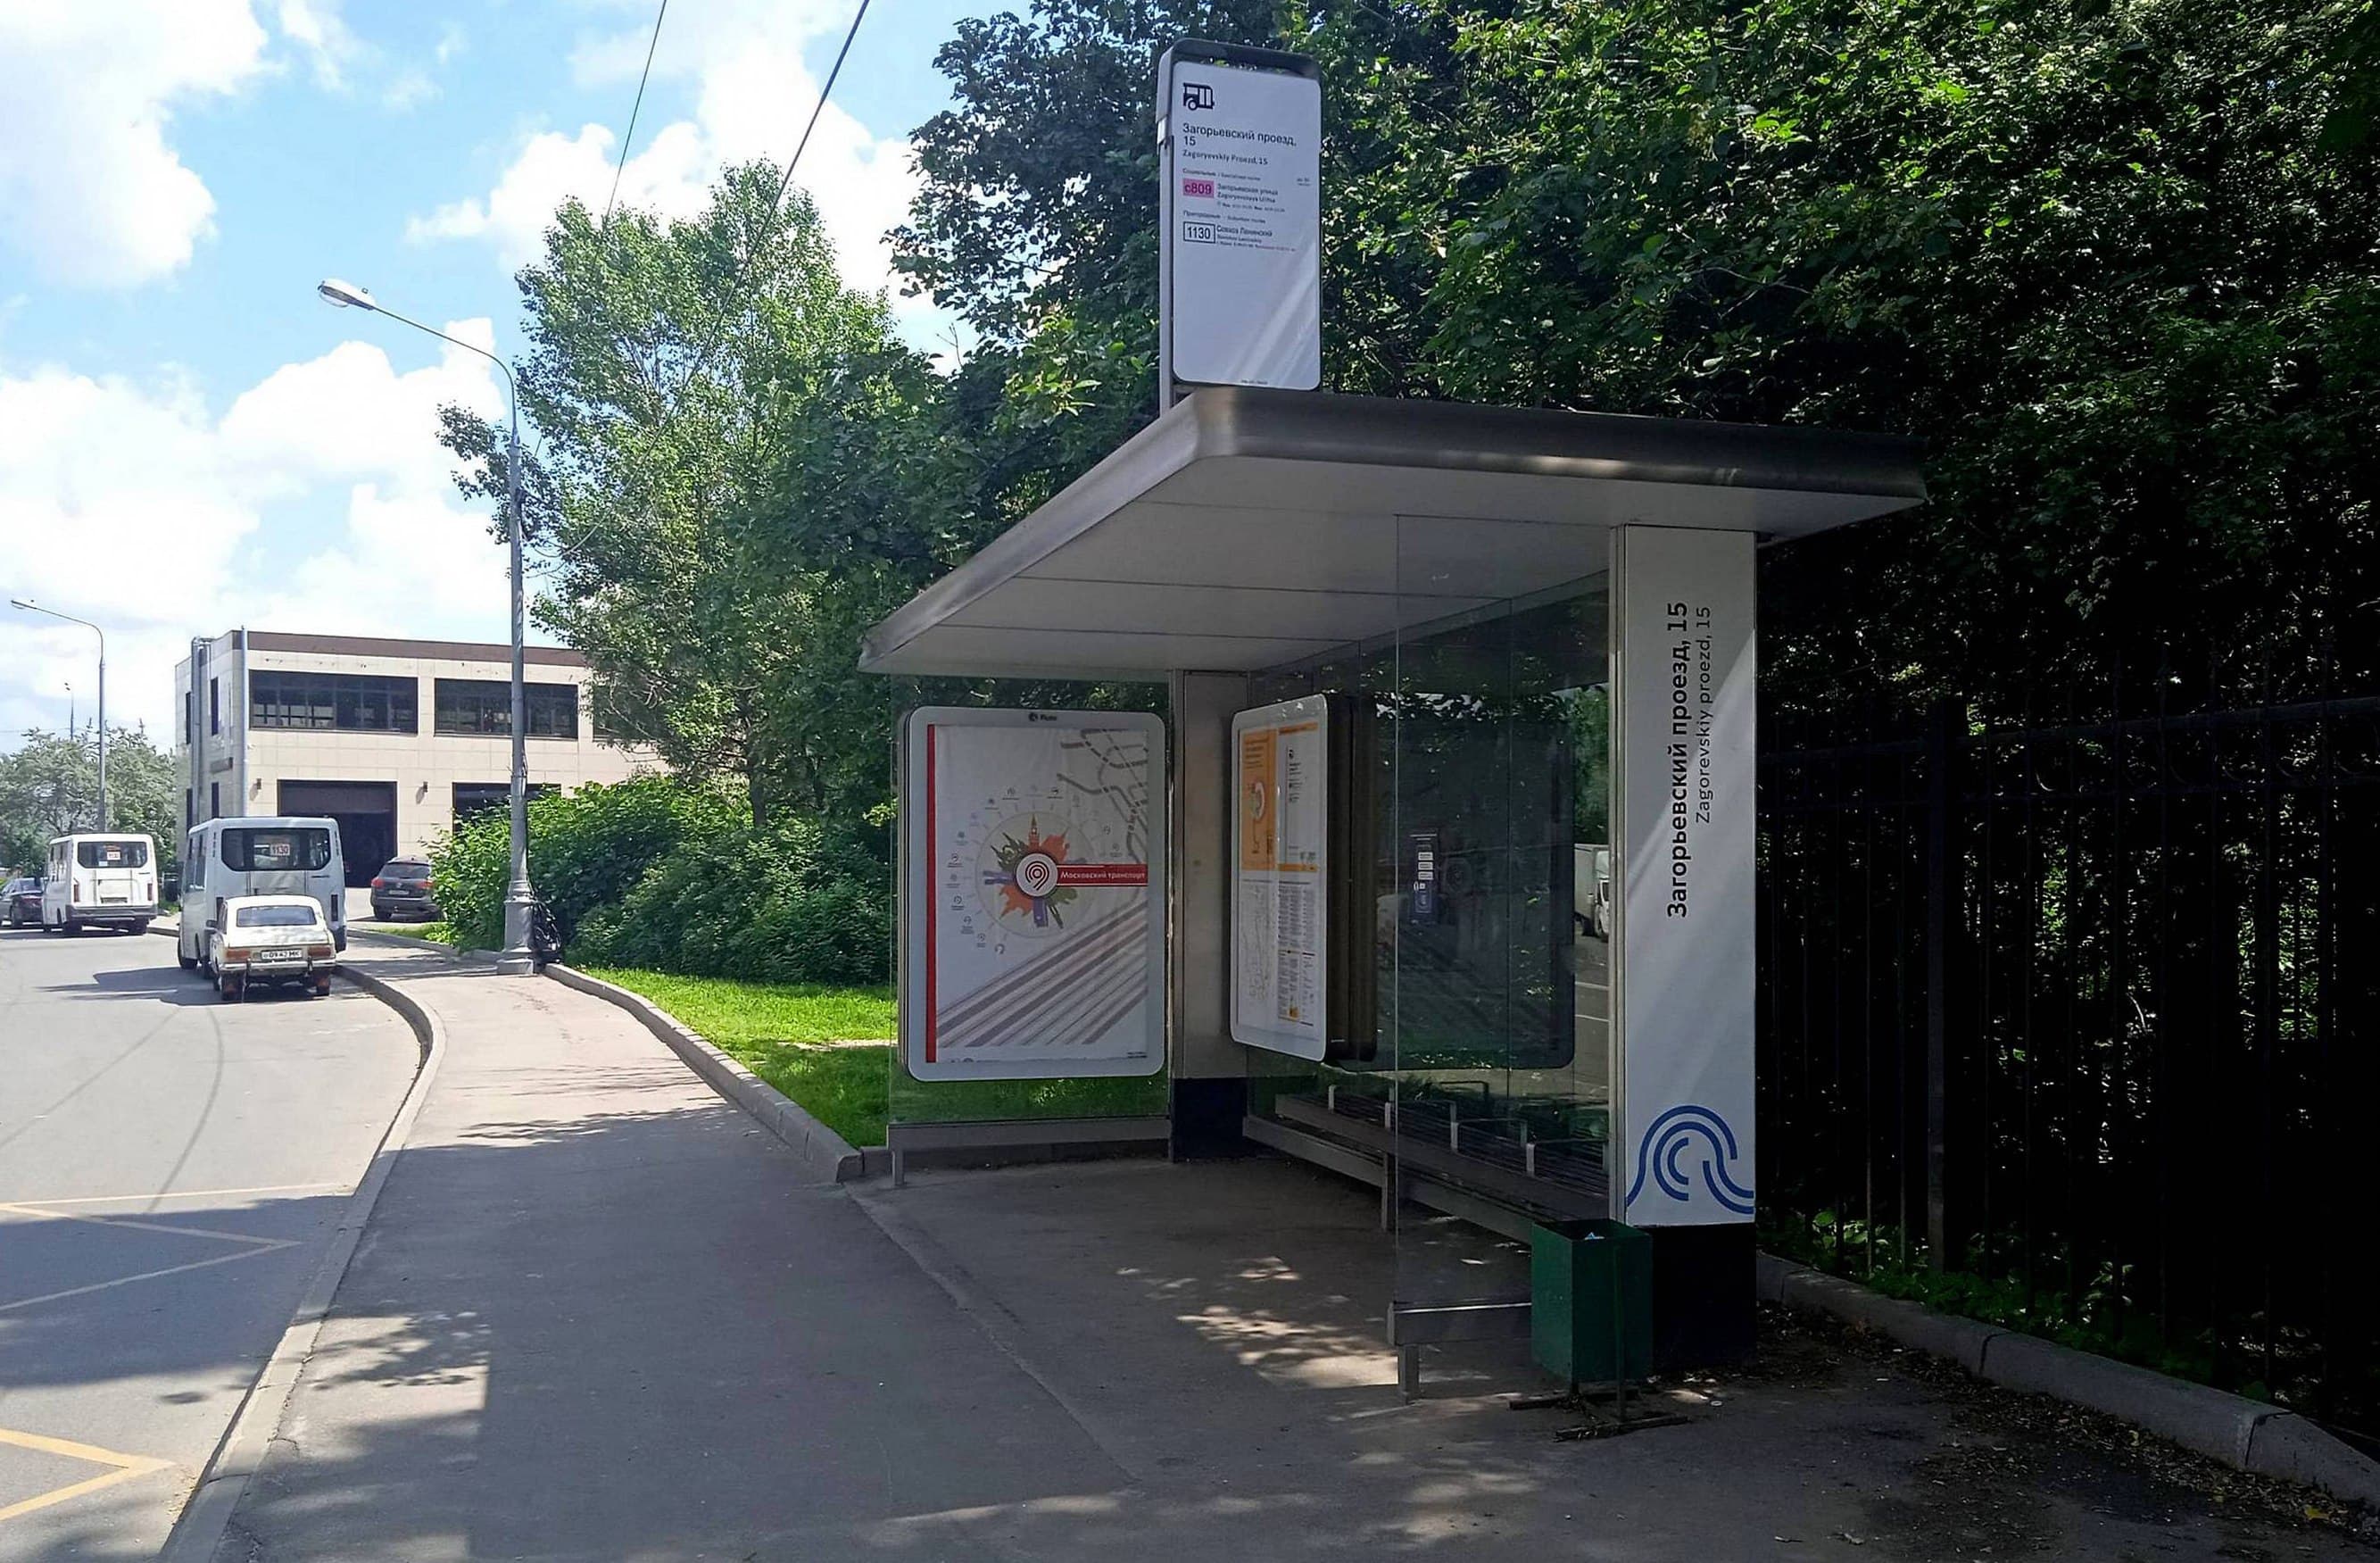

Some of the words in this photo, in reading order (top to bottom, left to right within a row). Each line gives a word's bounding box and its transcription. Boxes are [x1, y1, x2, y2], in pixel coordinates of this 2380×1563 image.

[1182, 122, 1256, 141] Загорьевский
[1183, 136, 1197, 146] 15
[1187, 226, 1211, 239] 1130
[1667, 603, 1688, 632] 15
[1696, 607, 1711, 628] 15
[1696, 635, 1713, 704] proezd,
[1672, 640, 1692, 736] проезд,
[1696, 710, 1713, 824] Zagorevskiy
[1667, 744, 1692, 918] Загорьевский
